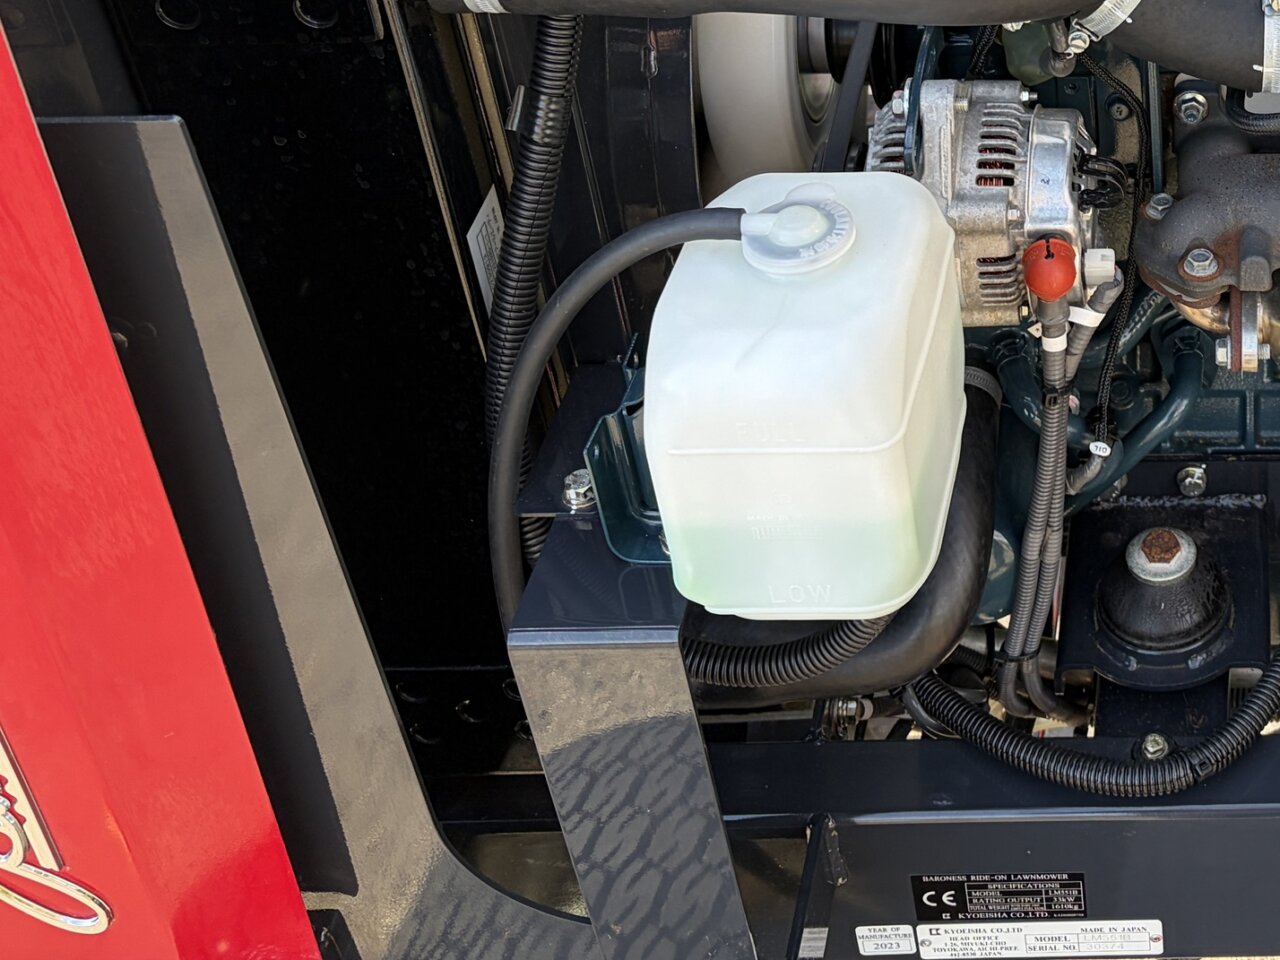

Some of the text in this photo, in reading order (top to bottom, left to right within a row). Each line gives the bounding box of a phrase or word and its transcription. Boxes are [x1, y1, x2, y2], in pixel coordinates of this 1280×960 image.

[734, 421, 807, 442] FULL
[767, 584, 832, 604] LOW
[922, 891, 957, 907] CE
[873, 942, 901, 950] 2023
